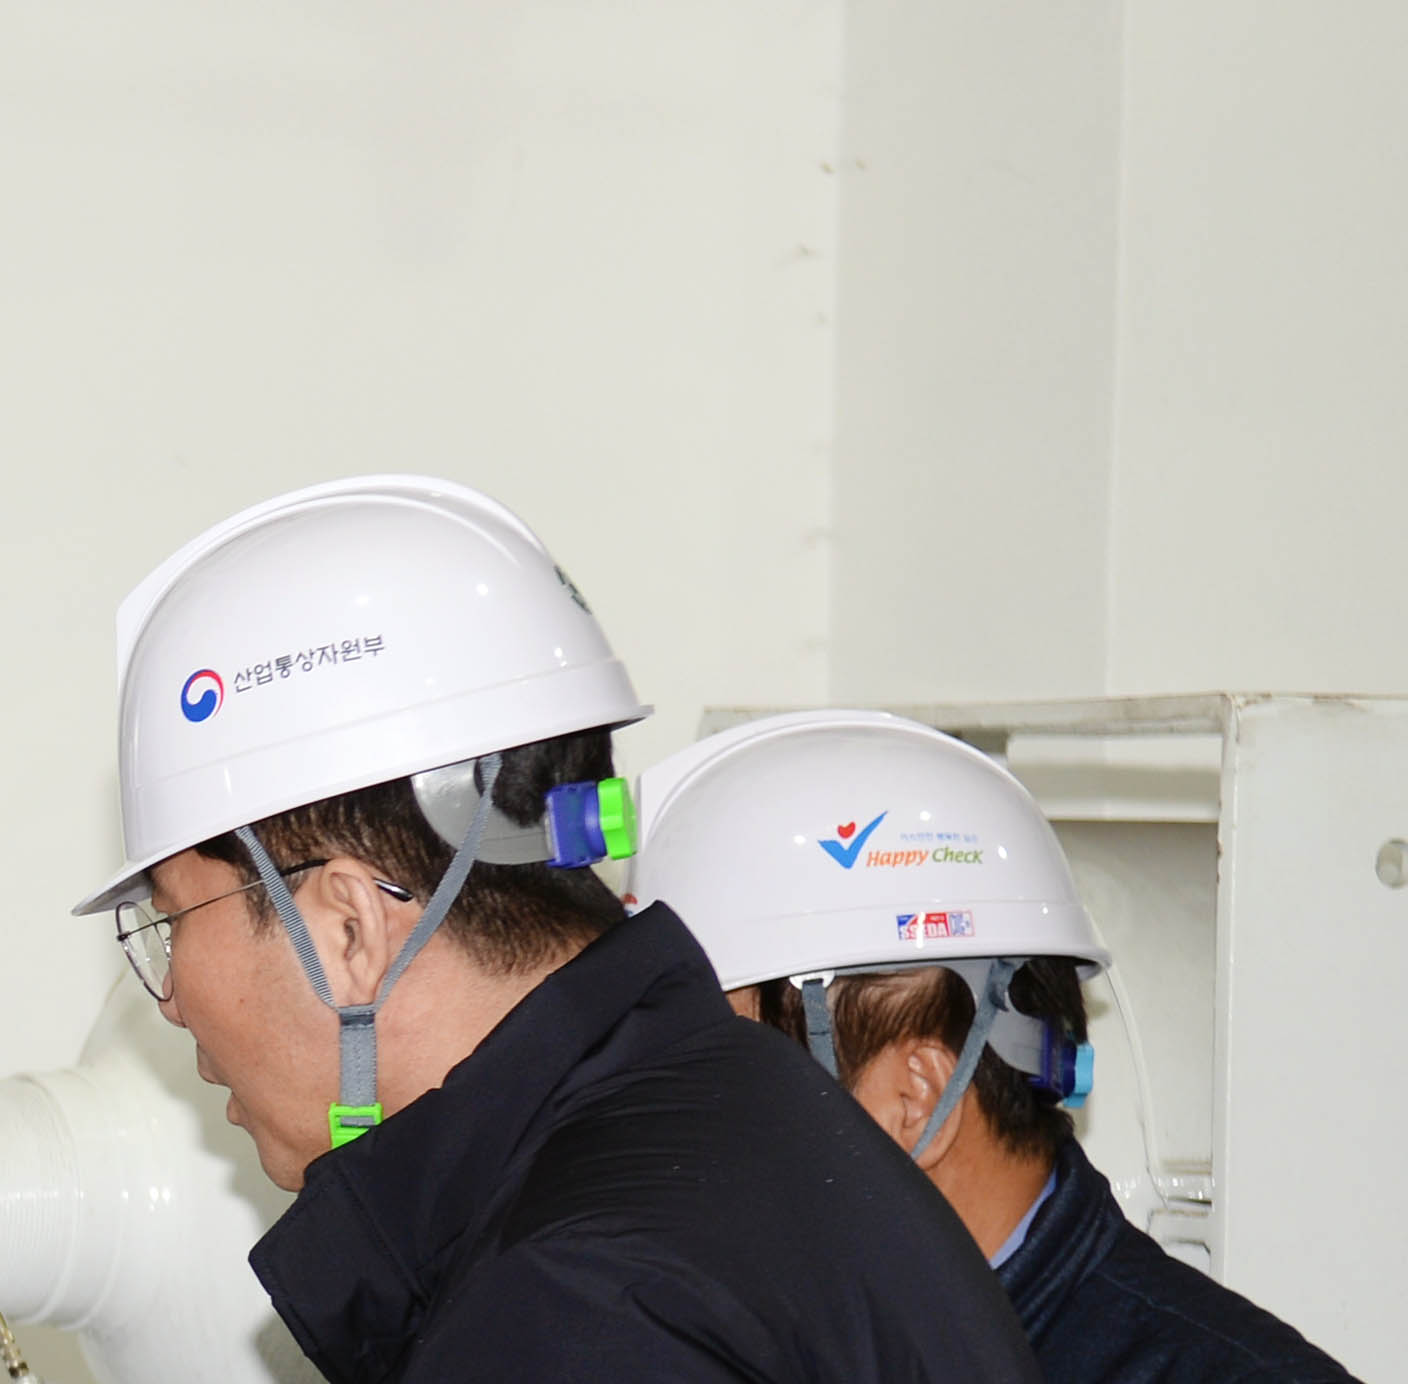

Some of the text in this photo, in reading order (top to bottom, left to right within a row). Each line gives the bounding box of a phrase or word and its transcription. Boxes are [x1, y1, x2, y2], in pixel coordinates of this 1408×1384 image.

[233, 634, 385, 693] 산업통상자원부
[866, 846, 984, 868] Happy Check
